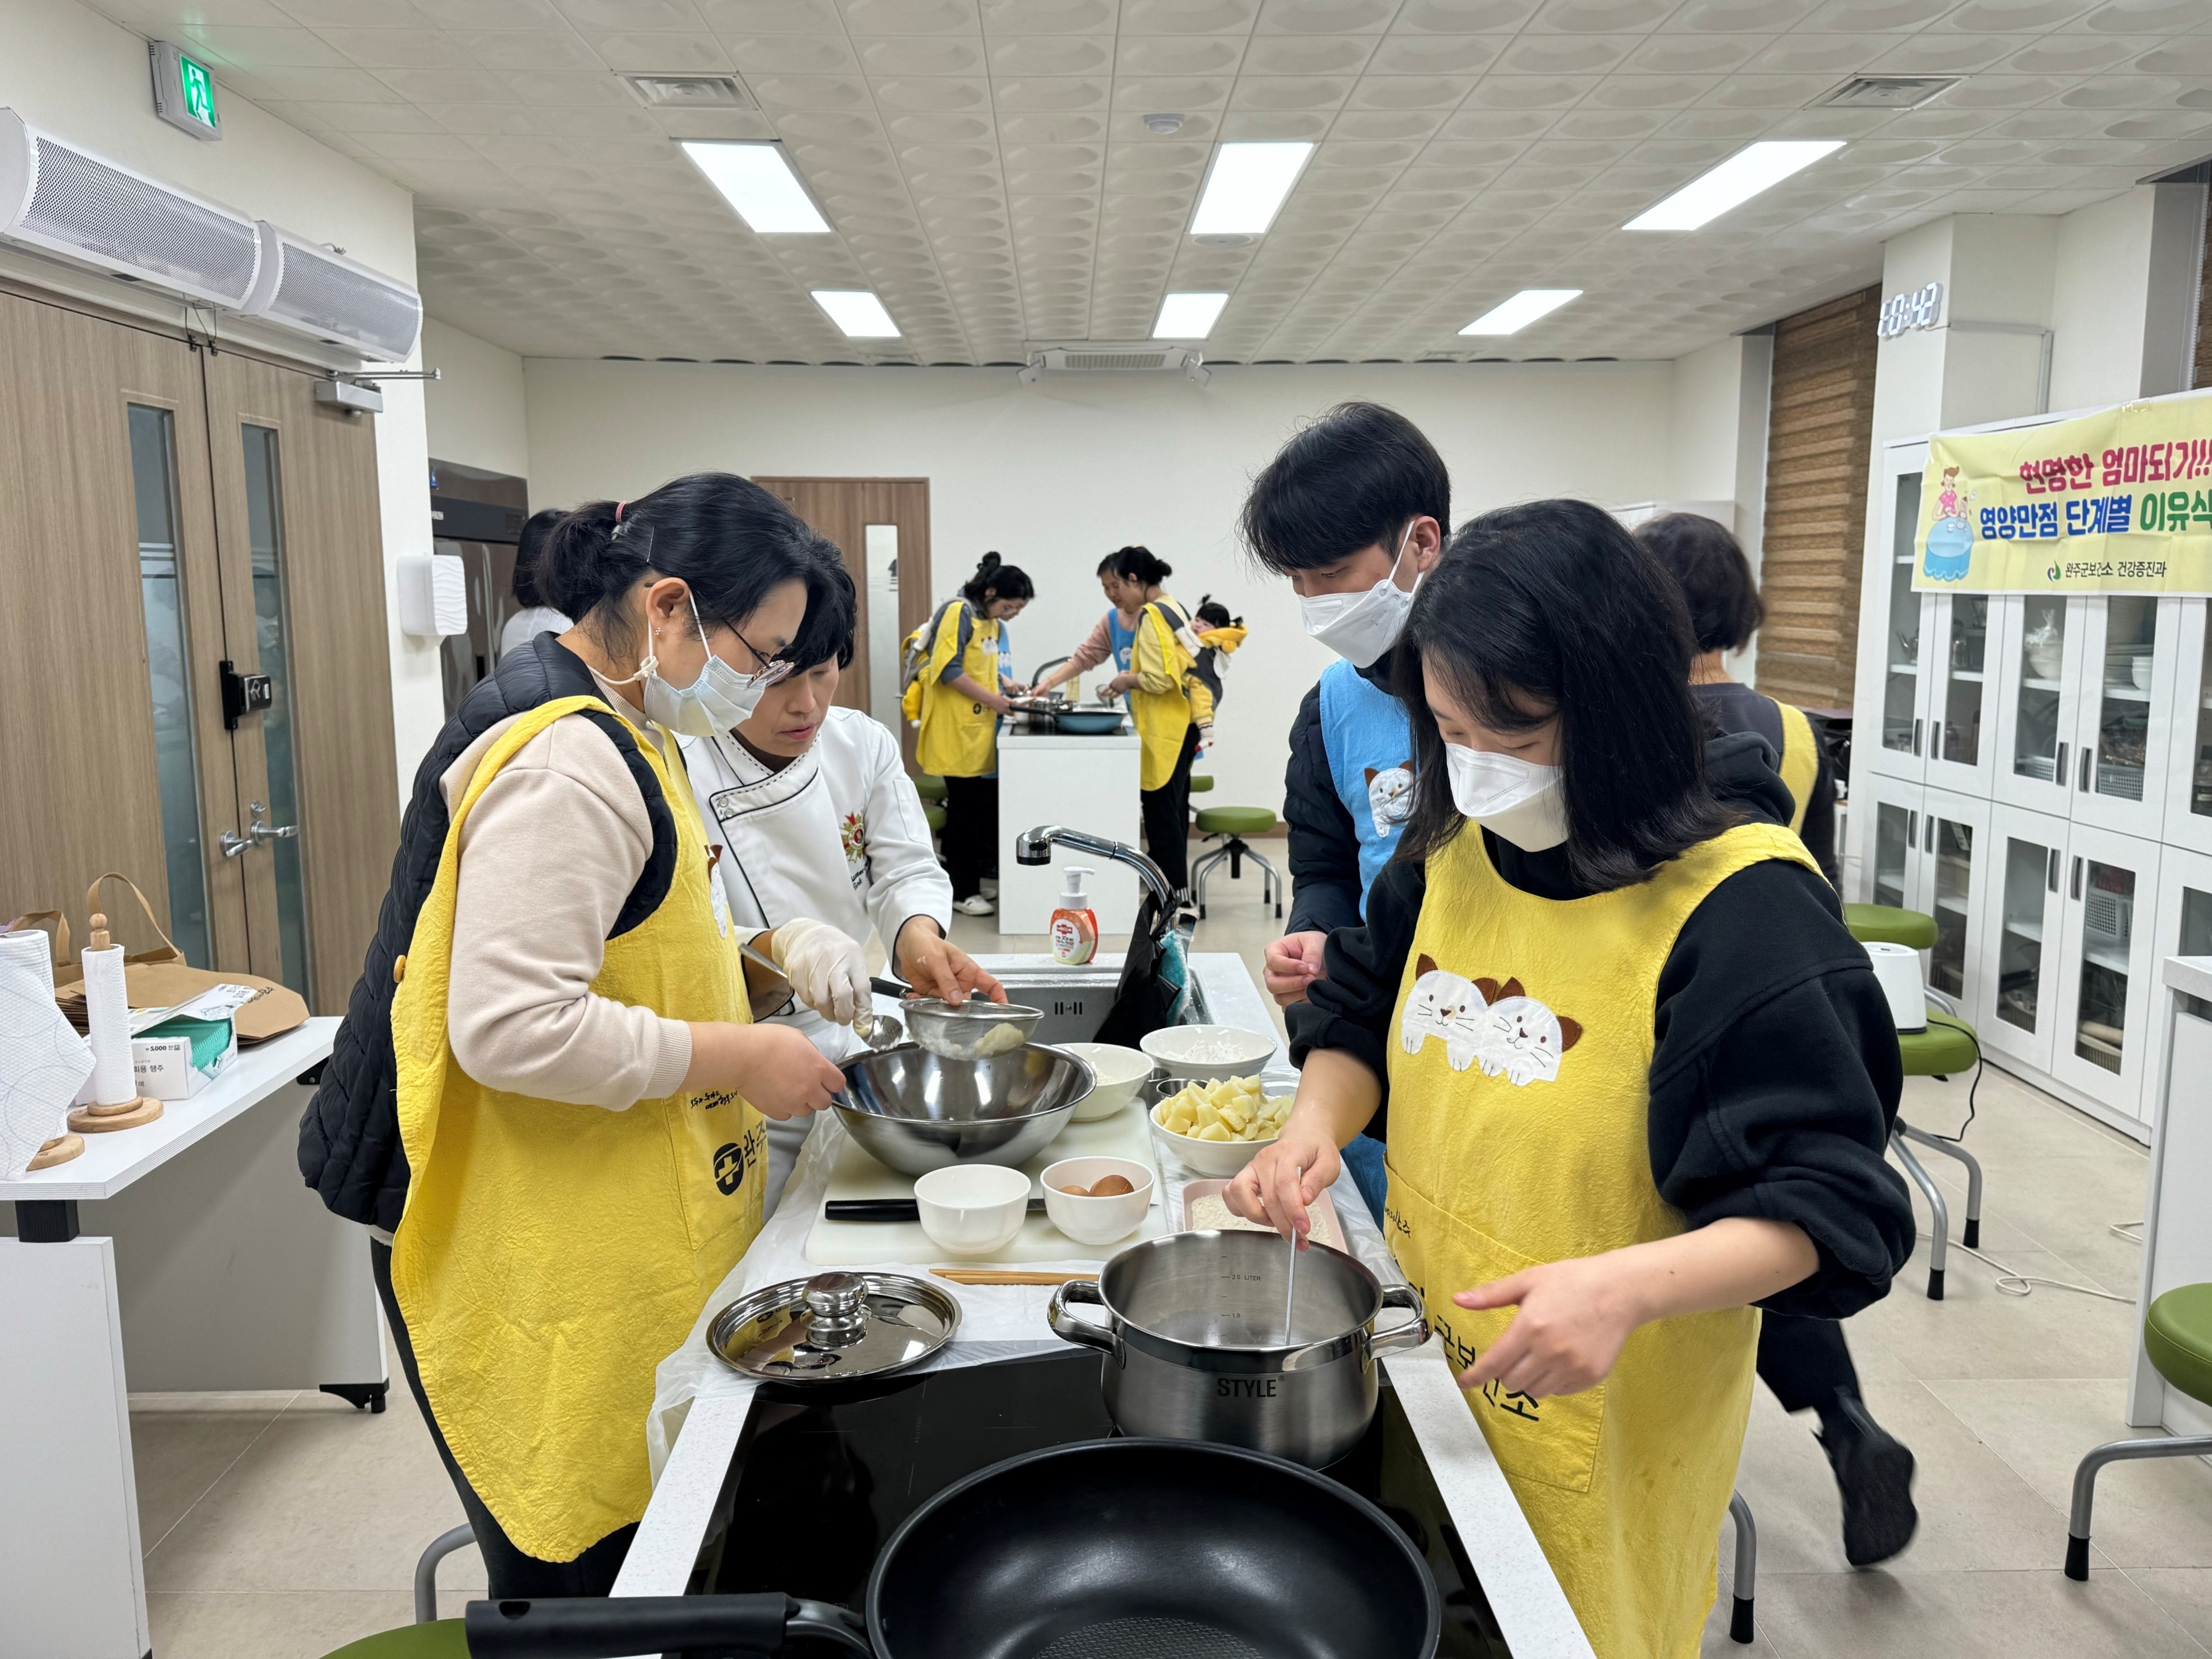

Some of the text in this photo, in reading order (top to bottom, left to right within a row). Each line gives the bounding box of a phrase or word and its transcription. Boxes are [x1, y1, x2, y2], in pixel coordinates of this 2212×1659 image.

[1877, 282, 1937, 336] 10:42
[2020, 453, 2094, 494] 현명한
[1980, 501, 2058, 540] 영양만점
[2066, 494, 2133, 536] 단계별
[2117, 561, 2167, 578] 건강증진과
[1217, 1378, 1277, 1397] STYLE
